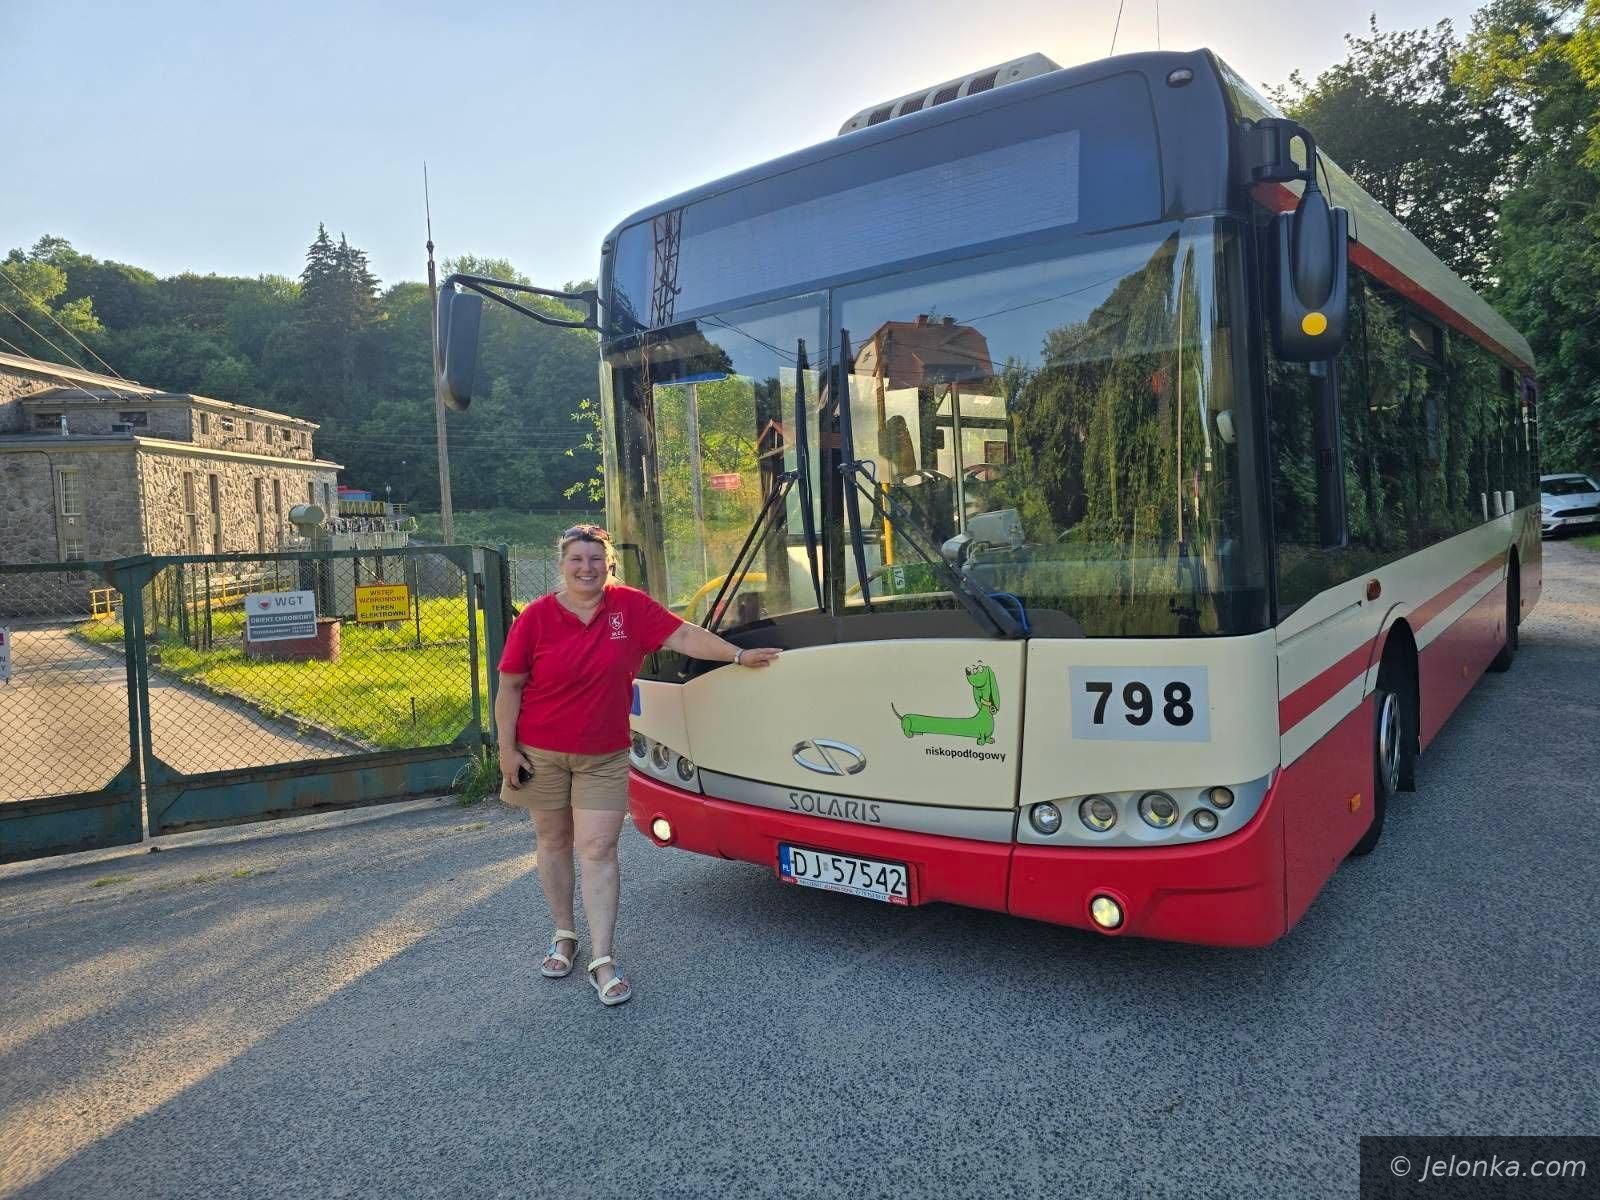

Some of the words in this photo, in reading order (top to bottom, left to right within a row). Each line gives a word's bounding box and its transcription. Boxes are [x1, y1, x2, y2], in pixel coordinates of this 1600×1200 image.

[359, 595, 406, 603] WZBRONIONY
[369, 589, 394, 598] WSTĘP
[274, 595, 304, 606] WGT
[360, 610, 406, 619] ELEKTROWNI
[1085, 681, 1194, 726] 798
[925, 746, 1006, 762] niskopodłogowy
[788, 792, 881, 823] SOLARIS
[831, 857, 903, 895] 57542
